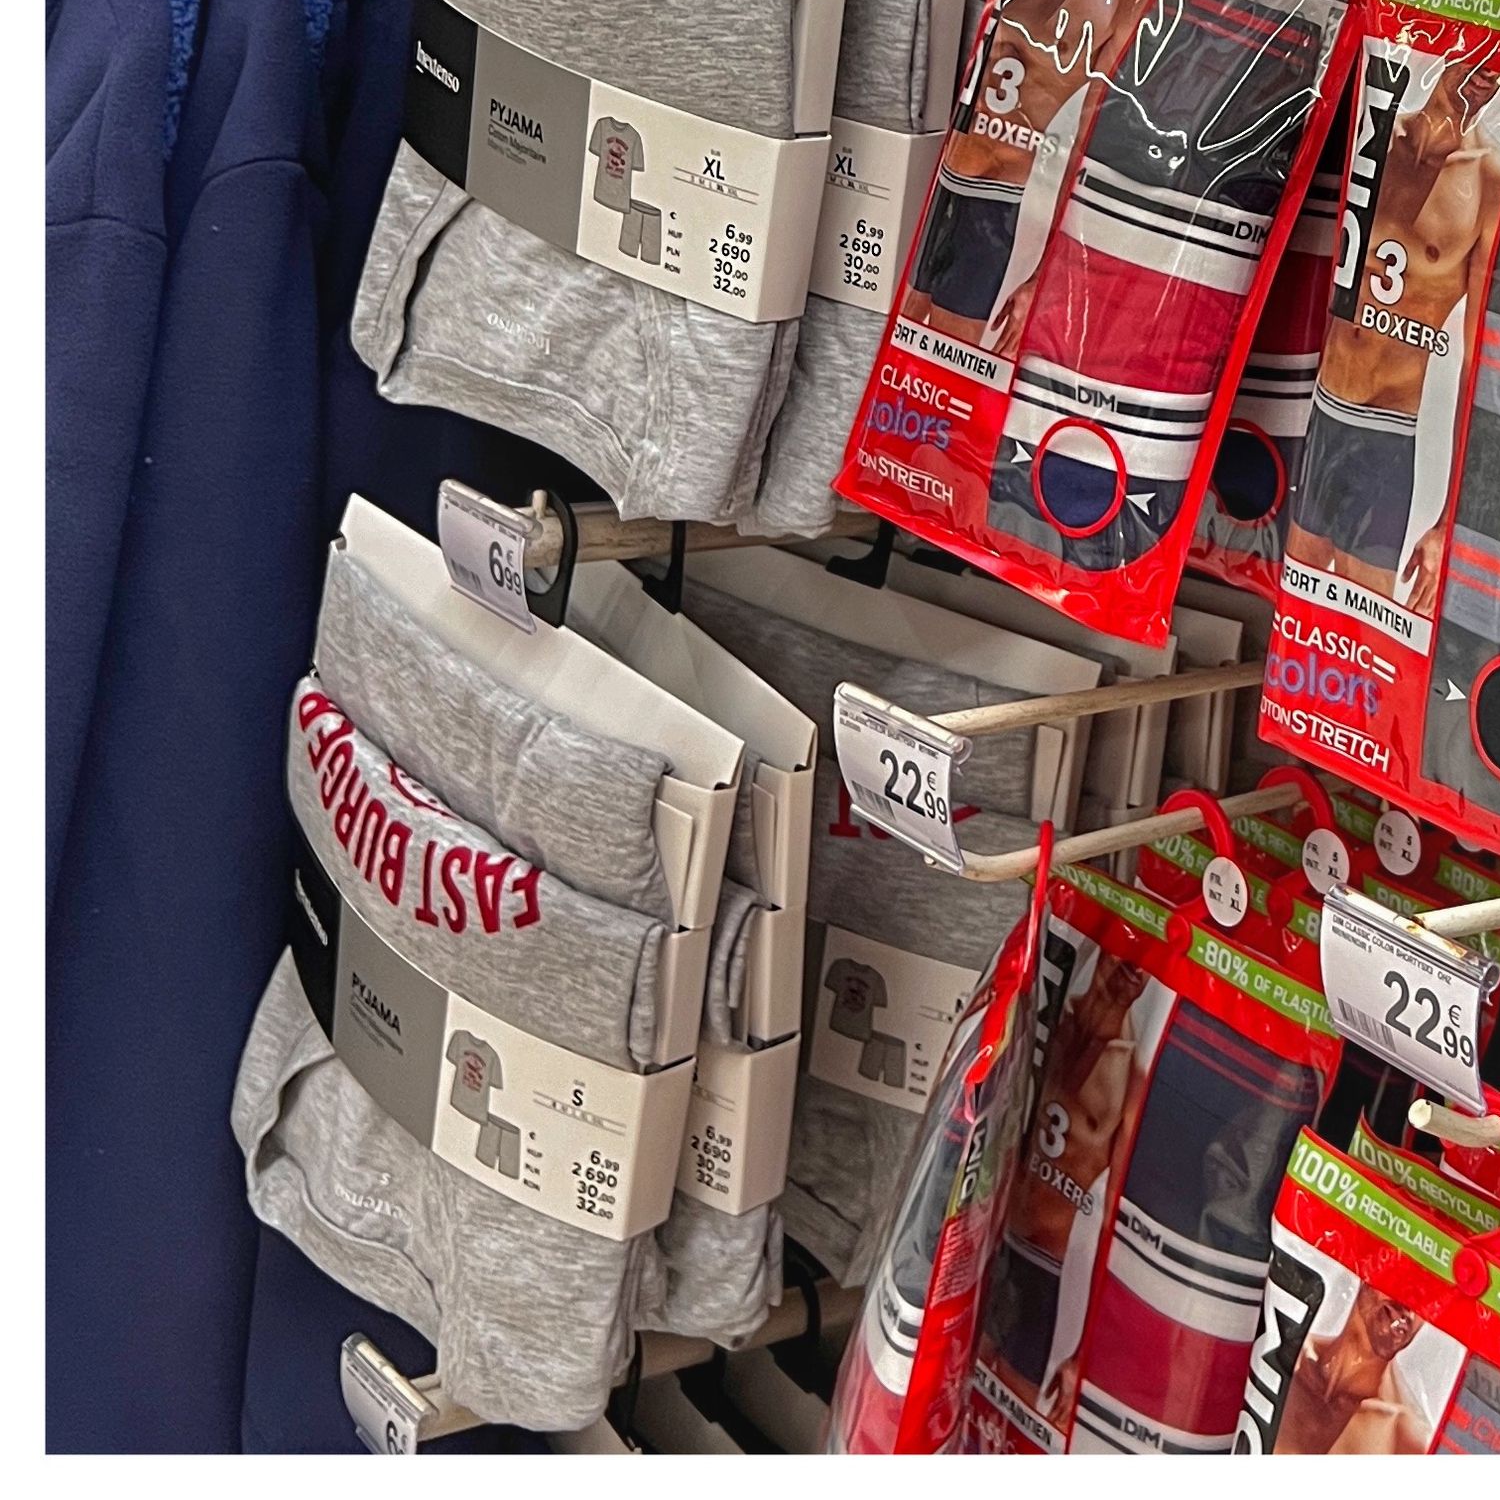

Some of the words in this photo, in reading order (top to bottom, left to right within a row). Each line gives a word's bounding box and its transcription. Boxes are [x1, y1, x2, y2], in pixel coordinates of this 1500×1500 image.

[985, 58, 1025, 114] 3
[490, 98, 543, 143] PYJAMA
[974, 113, 1060, 156] BOXERS
[702, 157, 726, 181] XL
[1369, 240, 1409, 305] 3
[1361, 304, 1449, 357] BOXERS
[933, 338, 998, 379] MAINTIEN
[880, 364, 949, 410] CLASSIC
[489, 540, 505, 587] 6
[1343, 589, 1413, 640] MAINTIEN
[1279, 615, 1373, 672] CLASSIC
[880, 750, 926, 817] 22
[924, 792, 948, 824] 99
[1345, 922, 1370, 943] CLASSIC
[1372, 936, 1394, 954] COLOR
[1383, 971, 1442, 1055] 22
[1443, 1026, 1473, 1068] 99
[572, 1089, 583, 1107] S
[1357, 1193, 1454, 1269] RECYCLABLE
